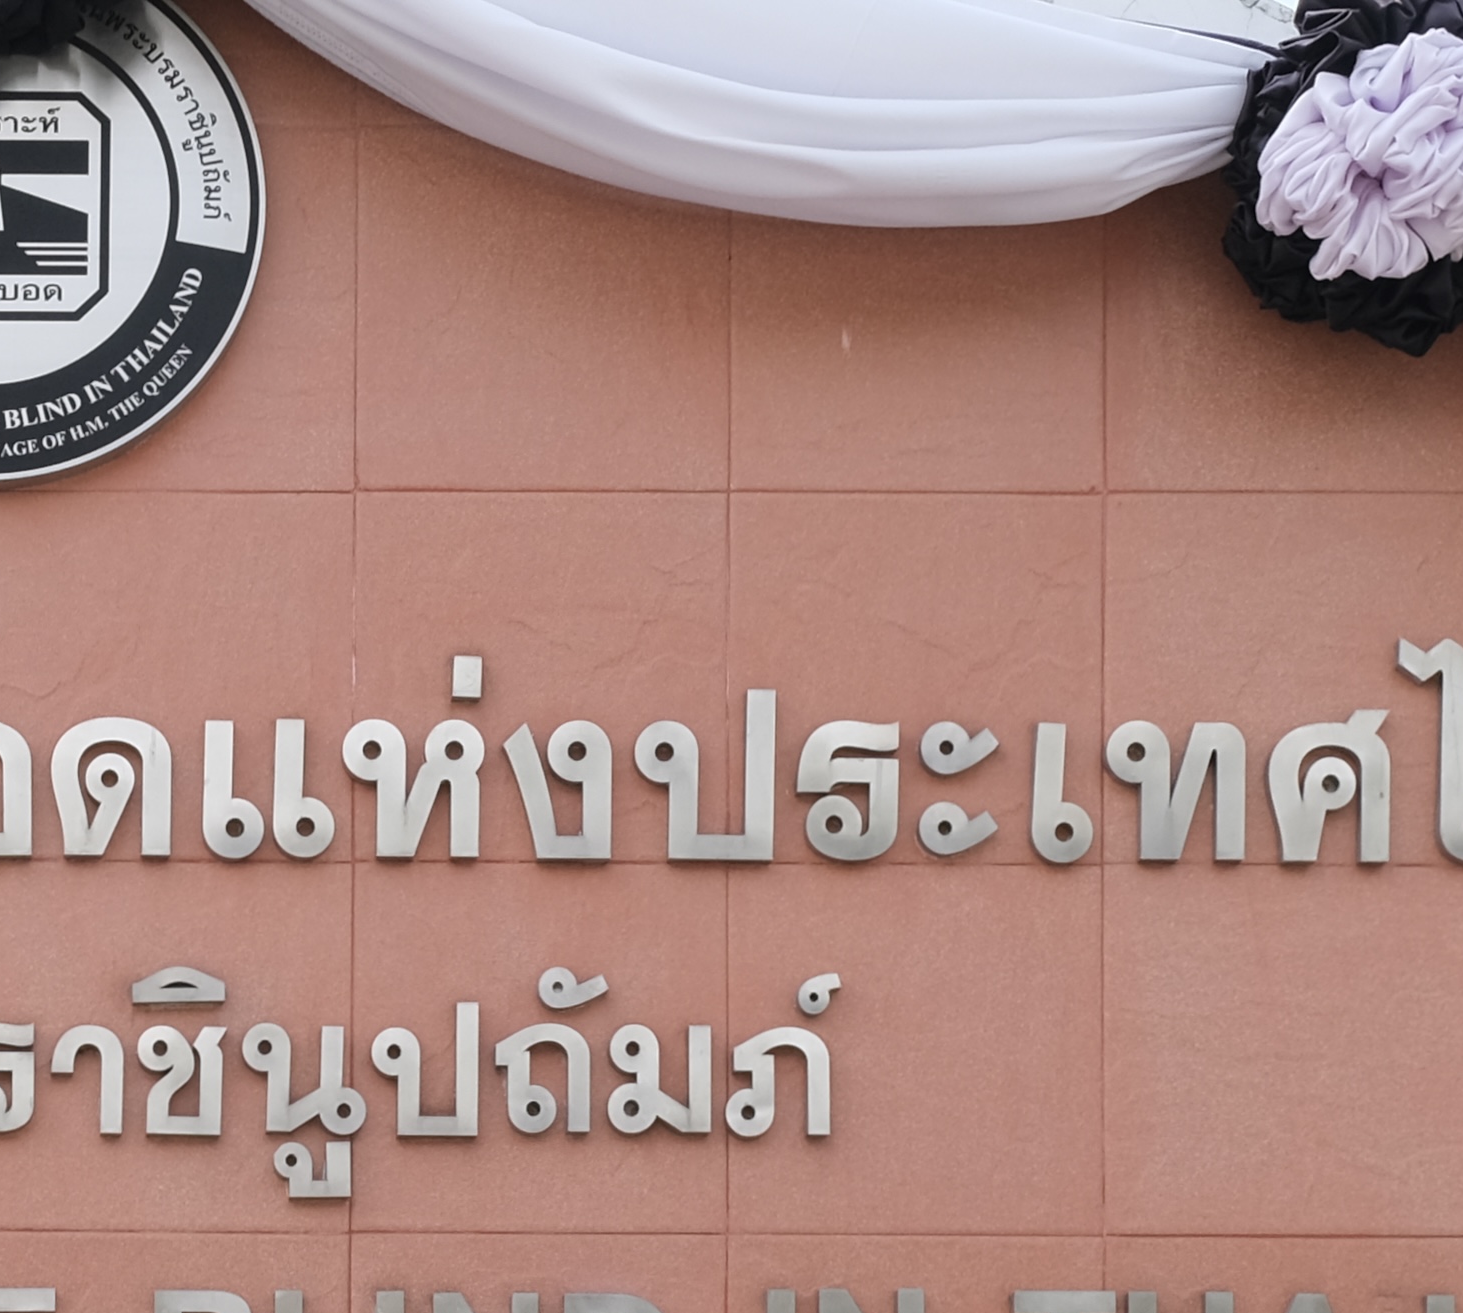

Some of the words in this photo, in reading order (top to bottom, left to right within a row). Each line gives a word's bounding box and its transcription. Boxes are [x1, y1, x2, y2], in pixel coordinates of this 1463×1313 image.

[3, 392, 82, 429] BLIND
[83, 374, 114, 404] IN
[110, 267, 203, 383] THAILAND
[41, 430, 67, 450] OF
[107, 392, 145, 422] THE
[142, 342, 193, 397] QUEEN
